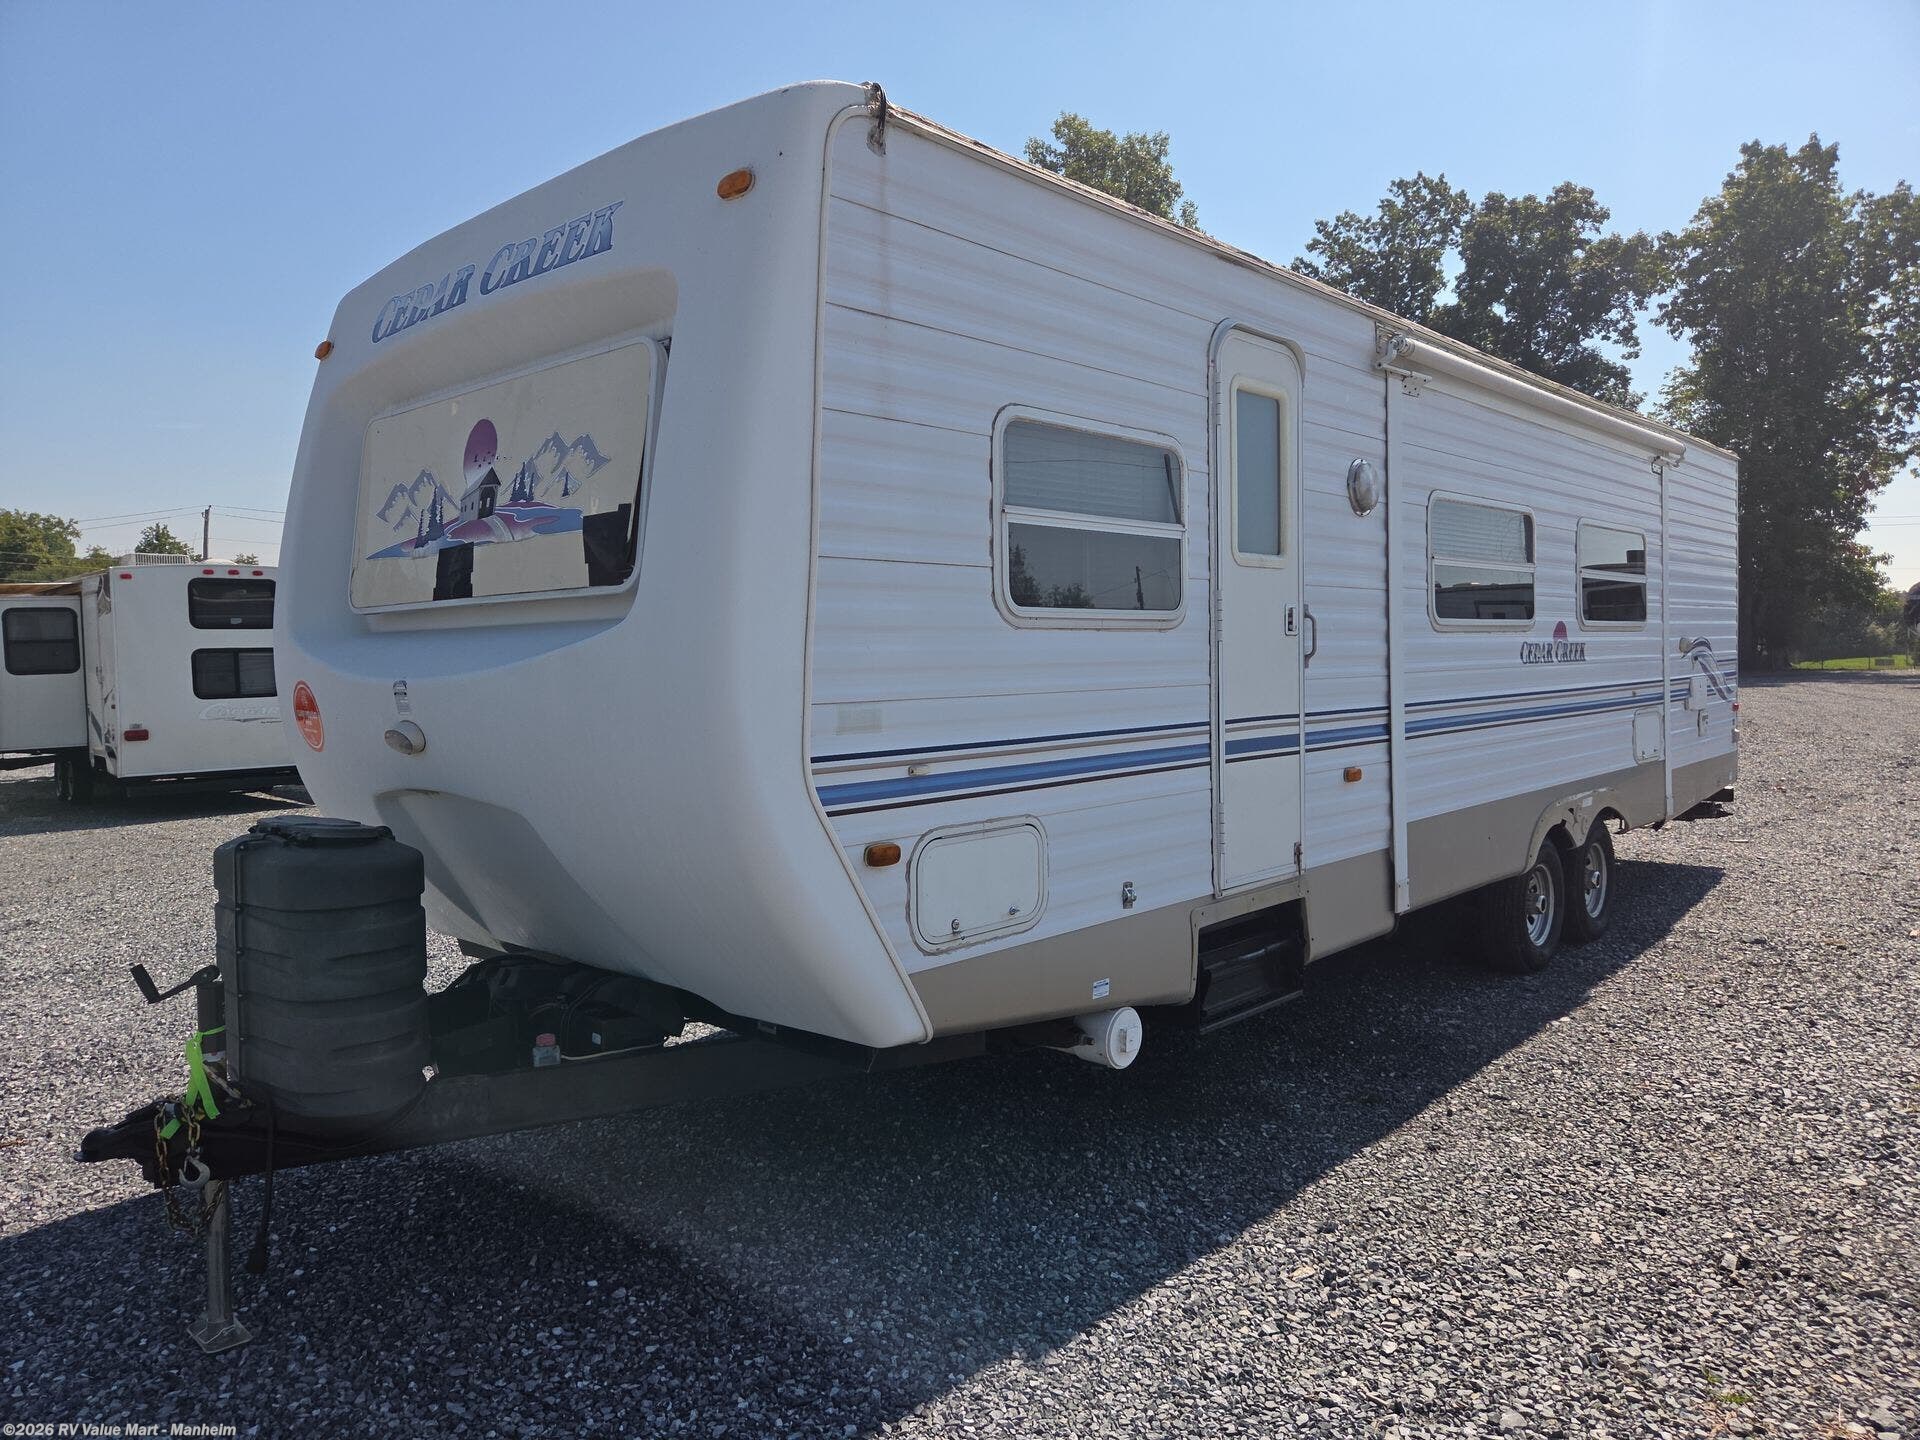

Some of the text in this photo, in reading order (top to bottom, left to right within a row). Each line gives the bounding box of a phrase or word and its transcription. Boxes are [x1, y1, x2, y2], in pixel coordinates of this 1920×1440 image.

[371, 200, 624, 343] CEDAR CREEK
[1520, 640, 1586, 664] CEDAR CREEK
